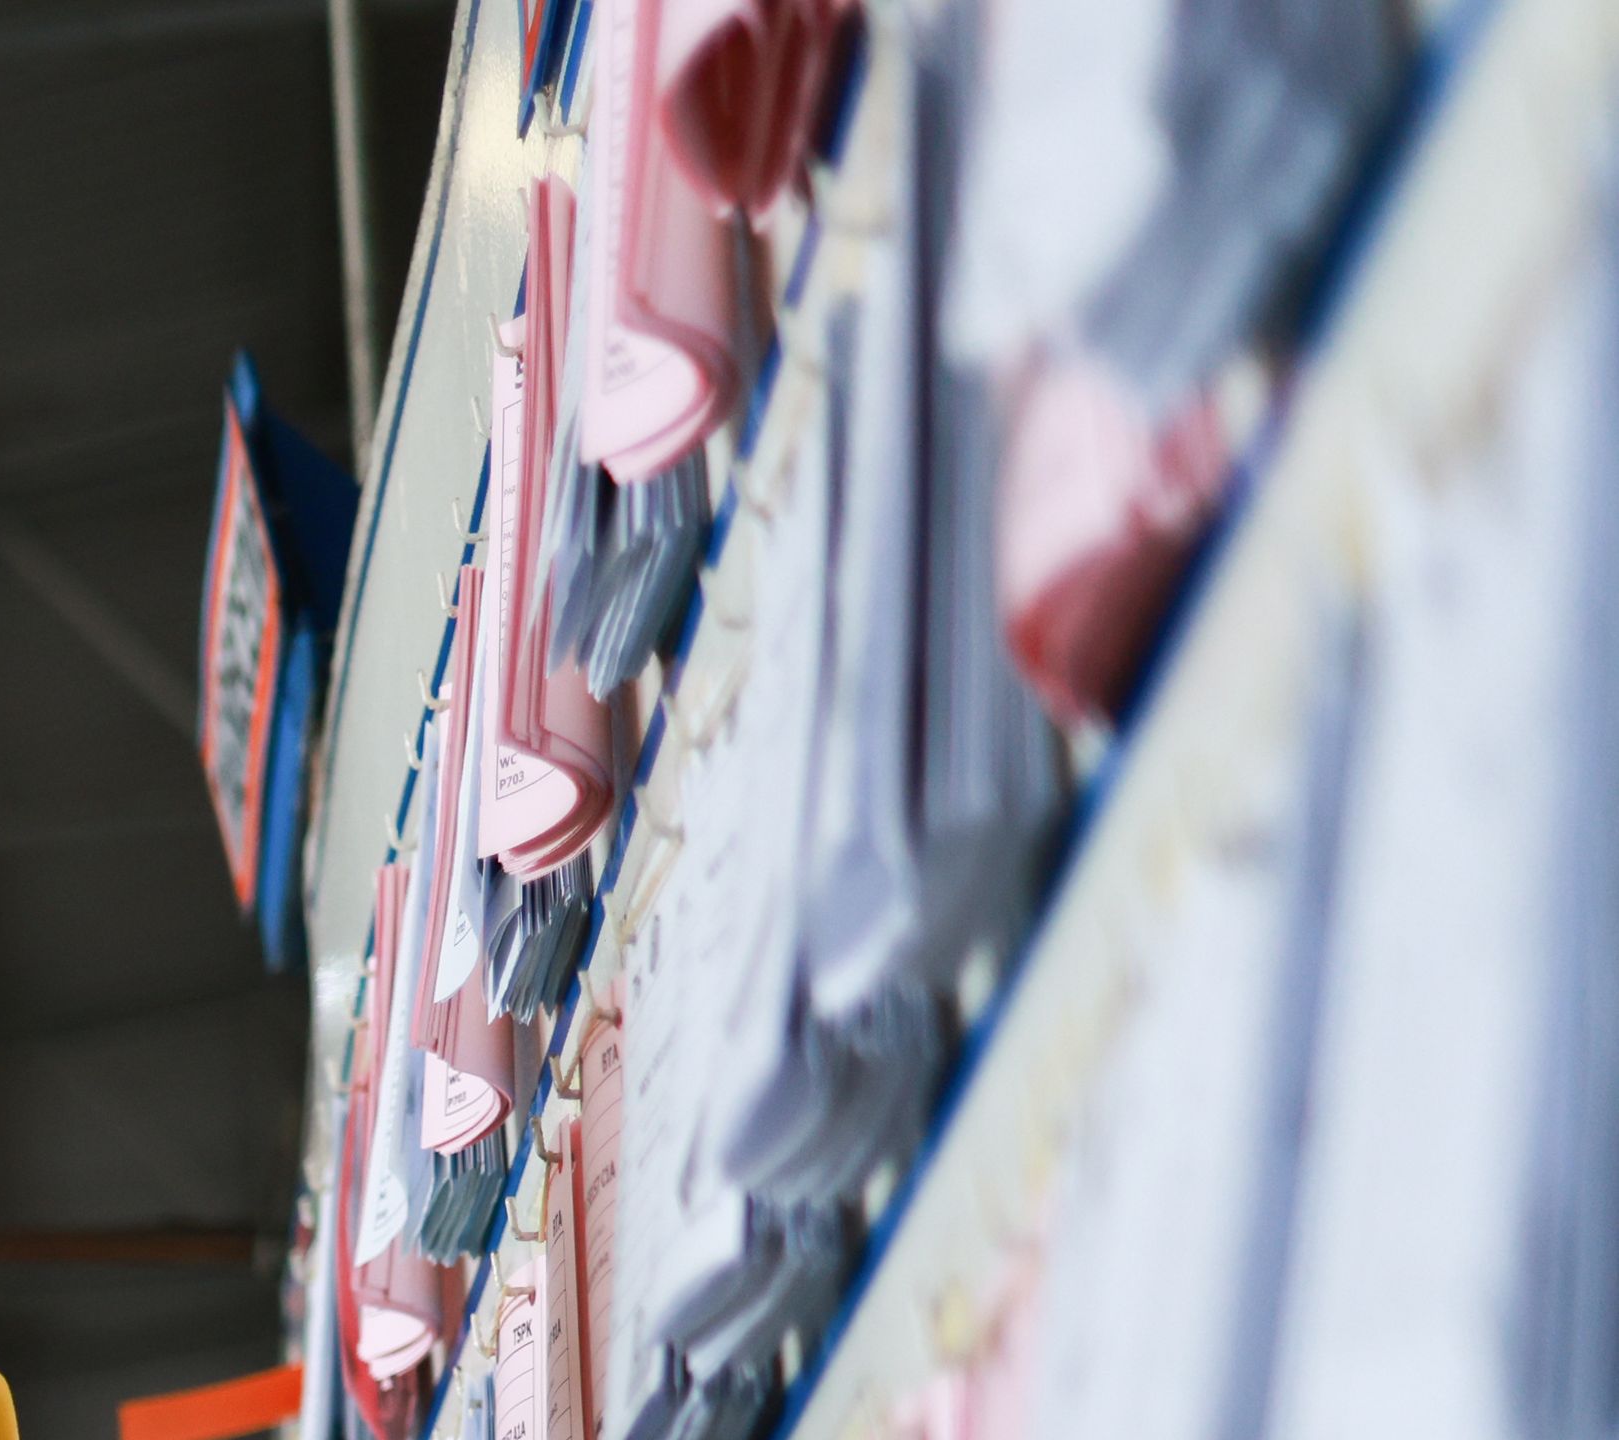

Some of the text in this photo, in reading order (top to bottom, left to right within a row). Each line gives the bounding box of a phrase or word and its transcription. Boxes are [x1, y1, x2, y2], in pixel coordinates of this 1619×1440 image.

[499, 751, 517, 769] WC
[498, 771, 525, 791] P703
[512, 1317, 533, 1346] TSPK
